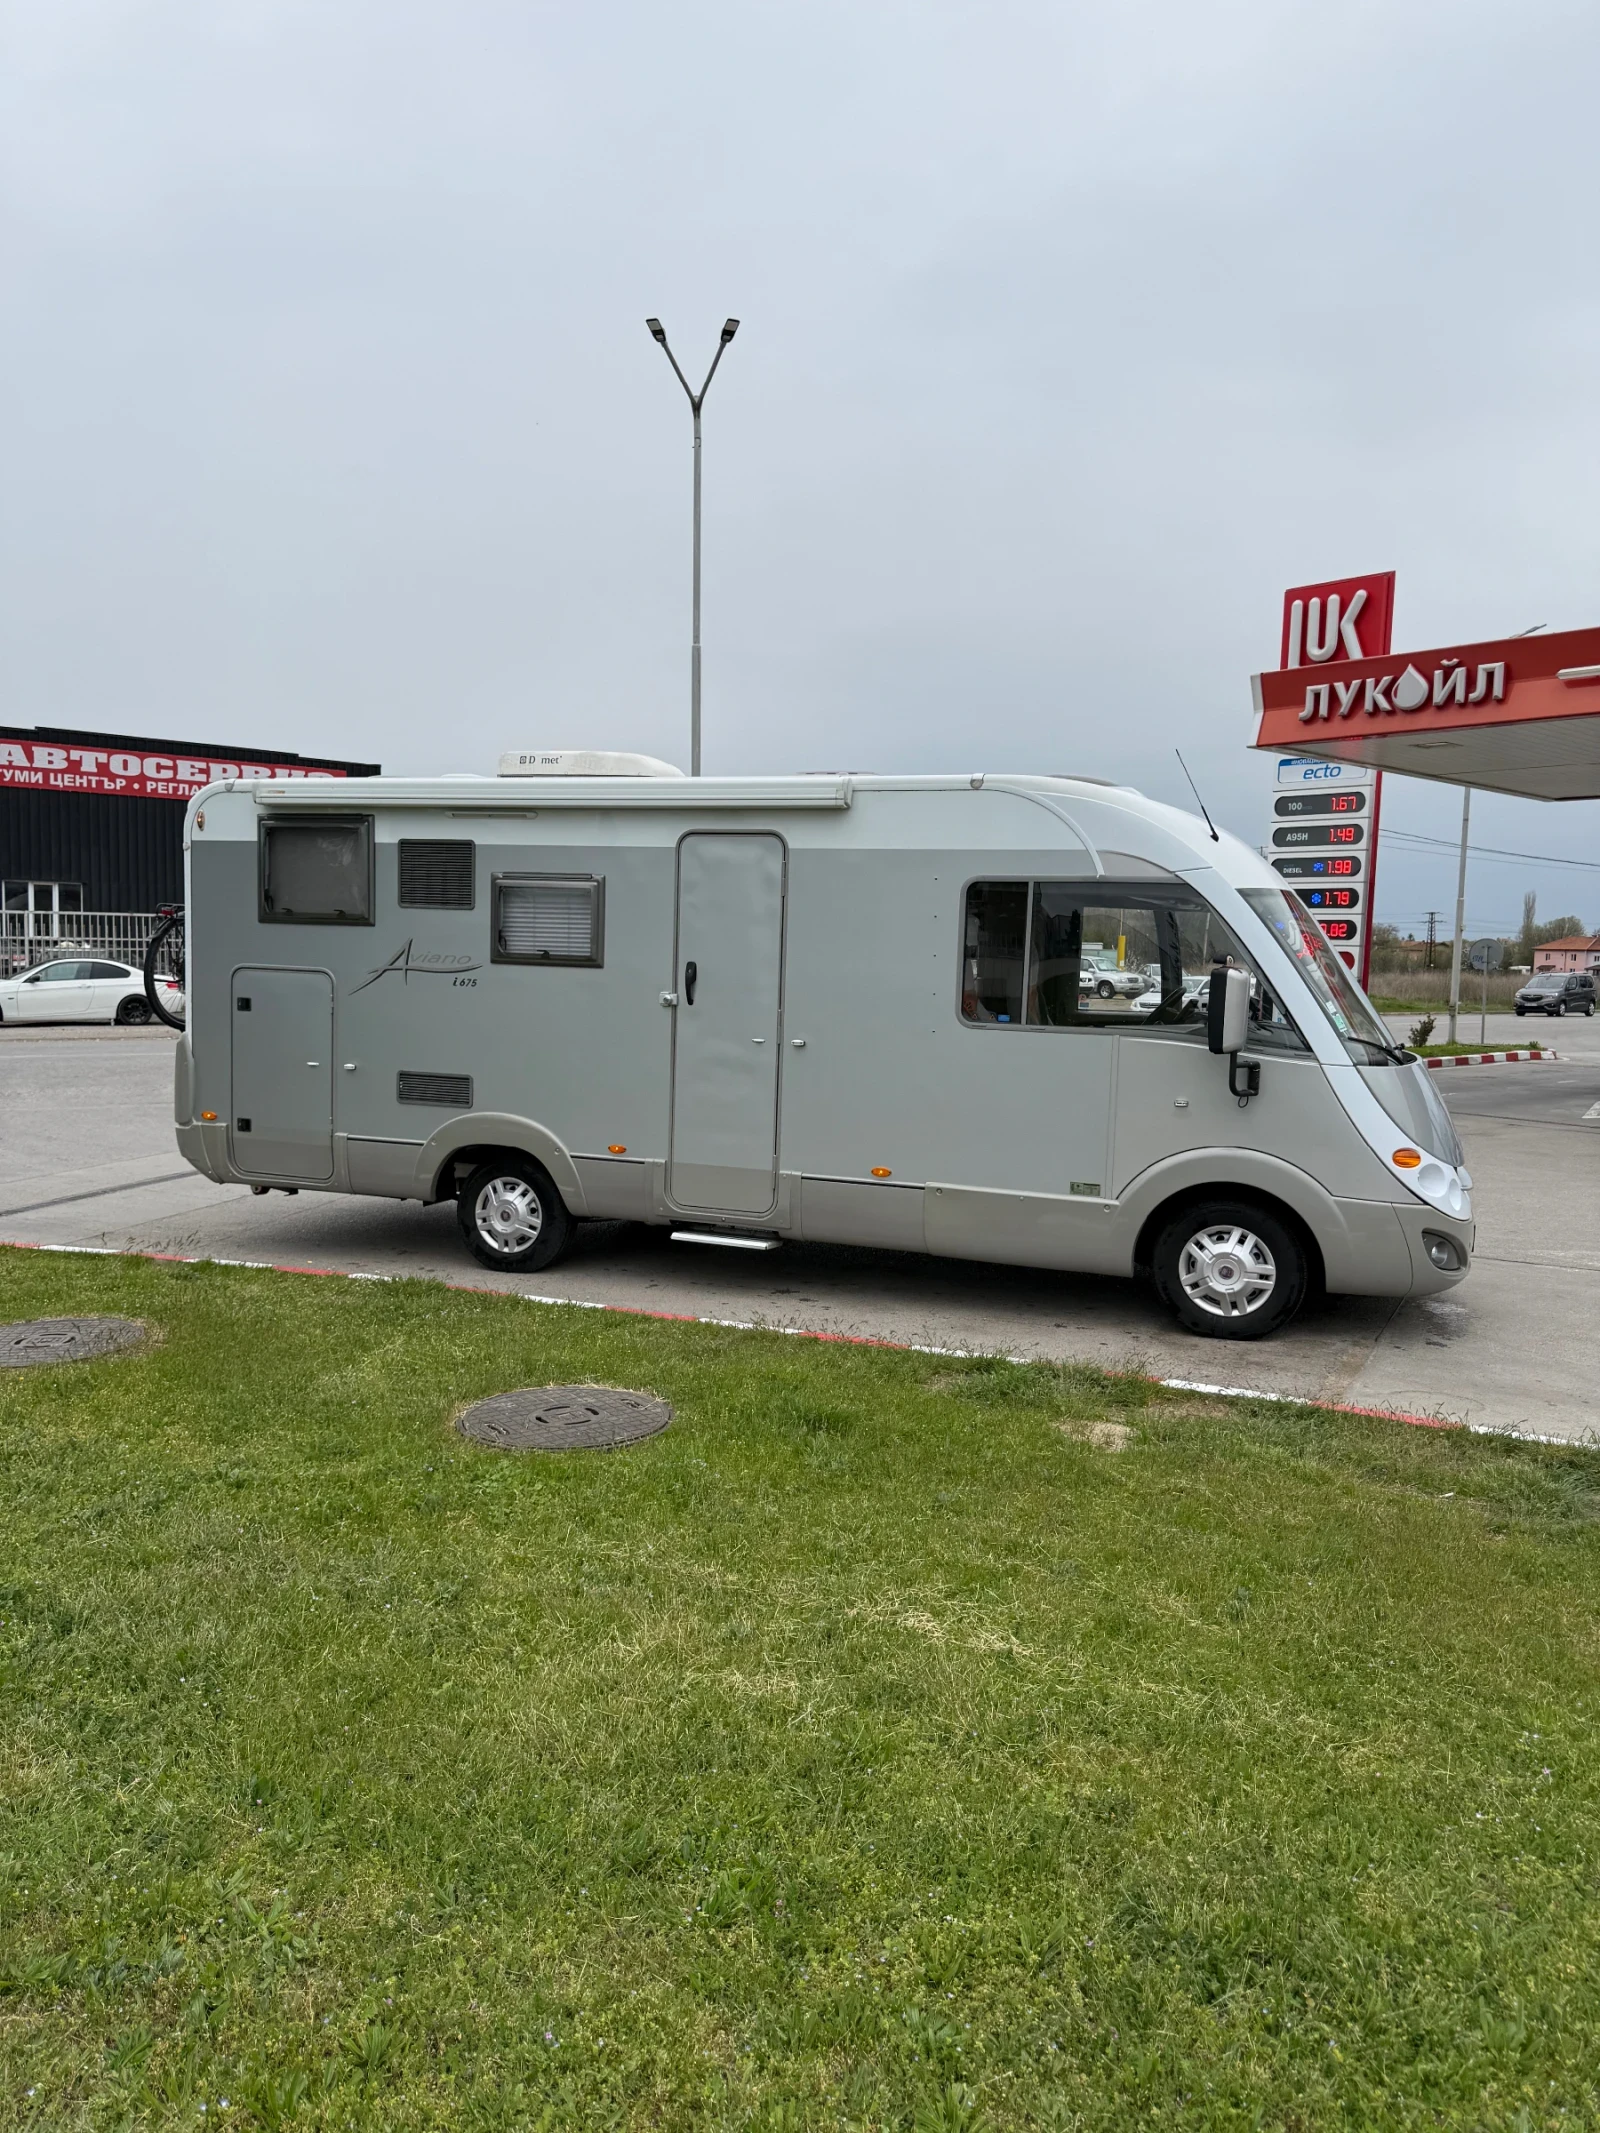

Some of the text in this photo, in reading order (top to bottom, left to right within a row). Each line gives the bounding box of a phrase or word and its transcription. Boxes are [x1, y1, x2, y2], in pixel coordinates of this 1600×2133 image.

[0, 744, 335, 783] АВТОСЕРВ
[1303, 764, 1342, 780] ecto
[49, 772, 127, 790] ЦЕНТЪР
[146, 780, 204, 796] РЕГЛА
[1287, 795, 1357, 811] 100 1.67
[1329, 827, 1355, 842] 1.49
[1327, 860, 1352, 874] 1.98
[1325, 891, 1350, 906] 1.79
